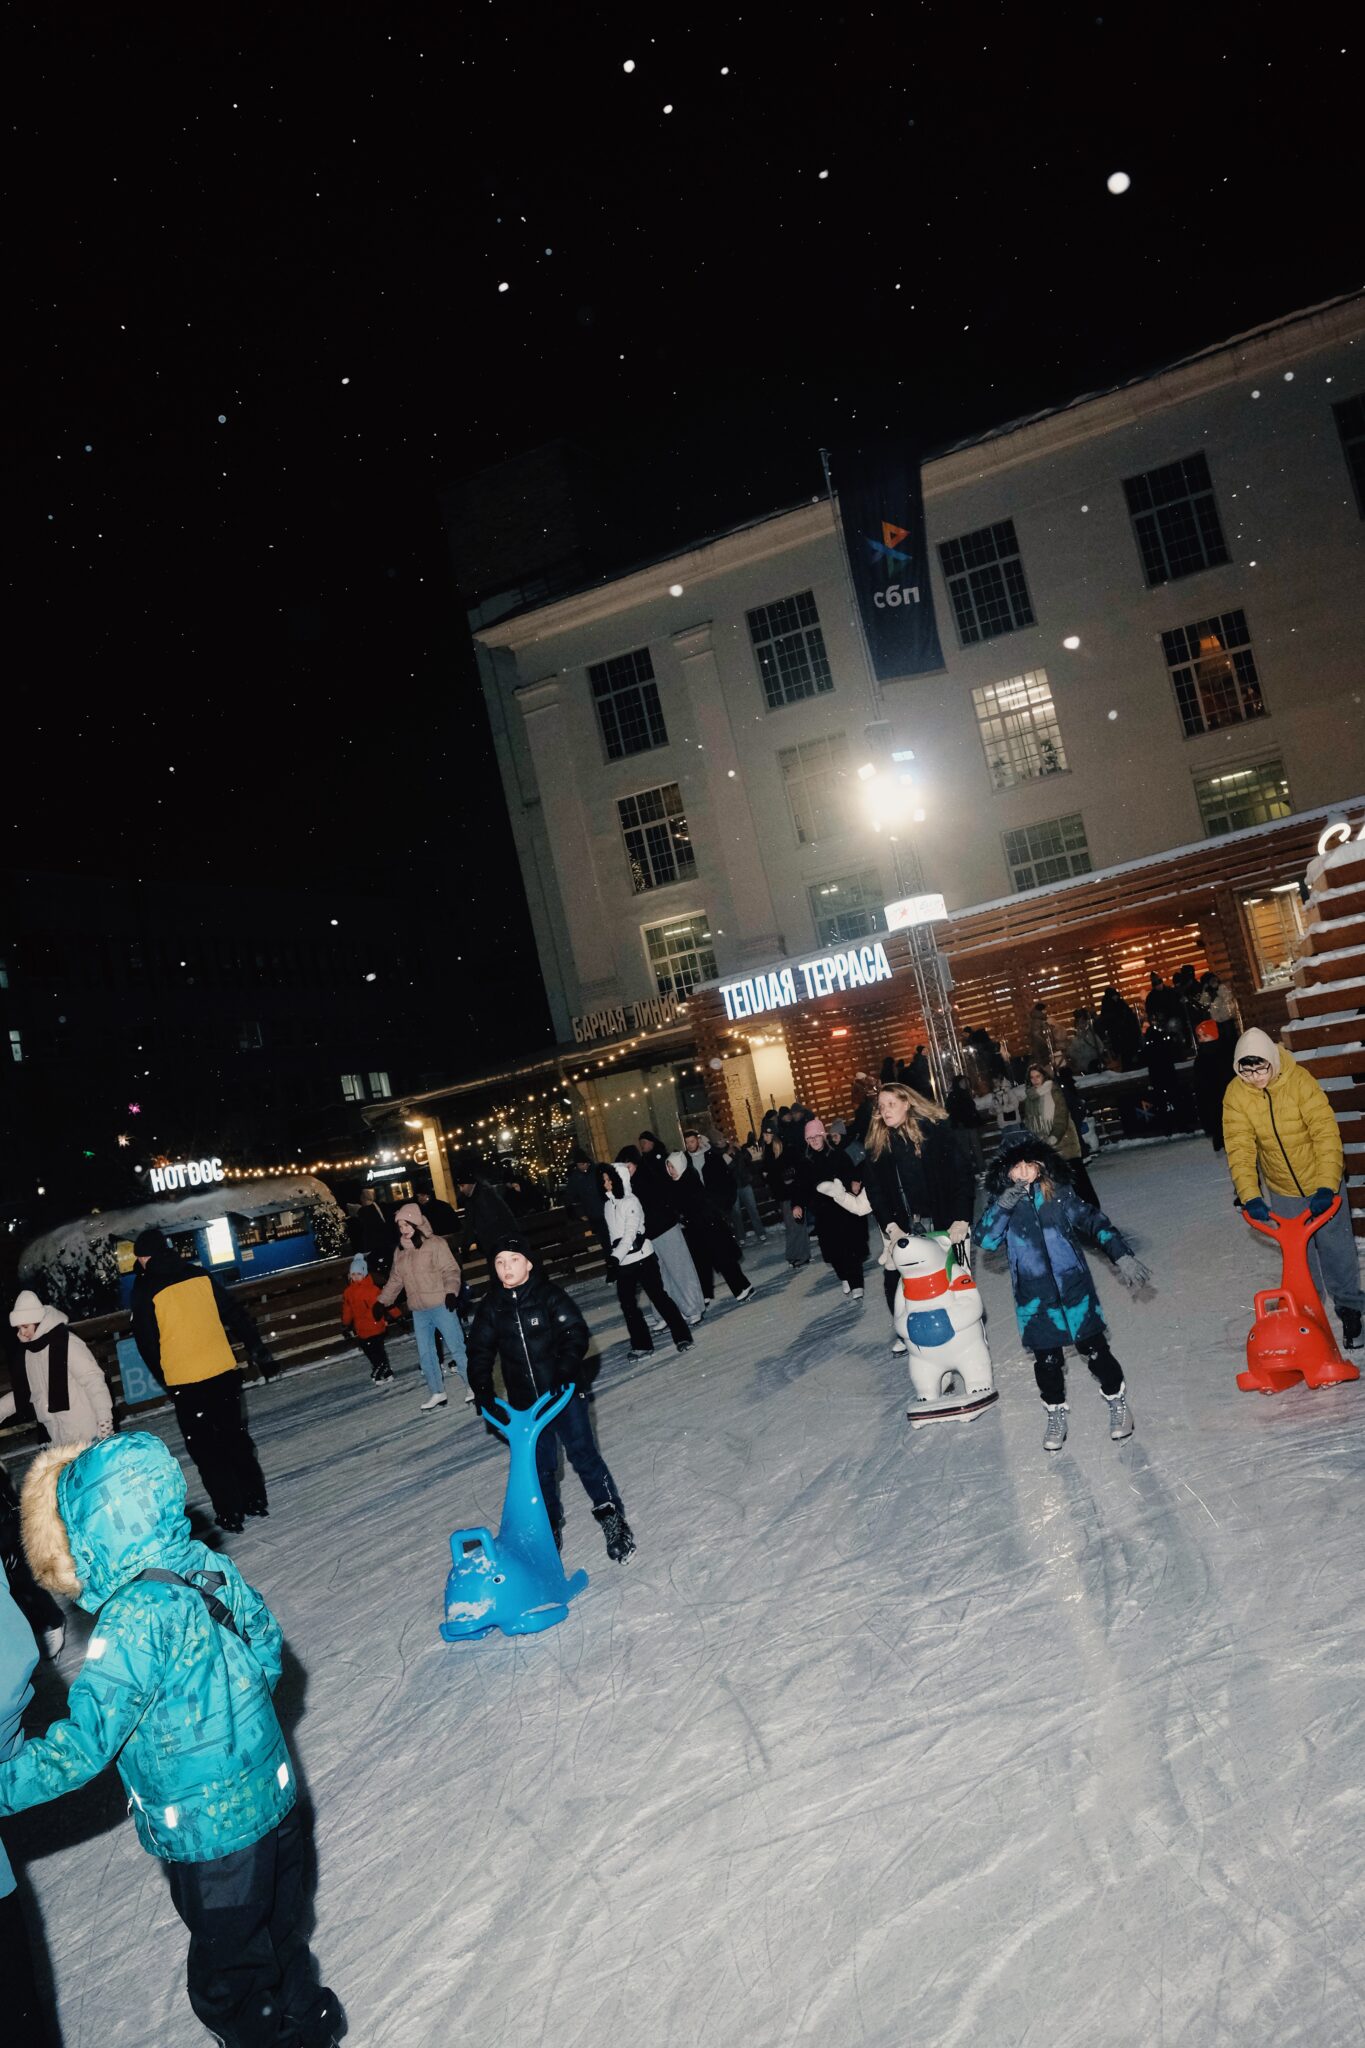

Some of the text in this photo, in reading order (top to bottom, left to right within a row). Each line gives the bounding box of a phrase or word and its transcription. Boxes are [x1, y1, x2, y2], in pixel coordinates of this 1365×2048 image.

[874, 585, 920, 608] сбп
[719, 943, 892, 1020] ТЕПЛАЯ ТЕРРАСА
[572, 992, 680, 1043] БАРНАЯ ЛИНИЯ
